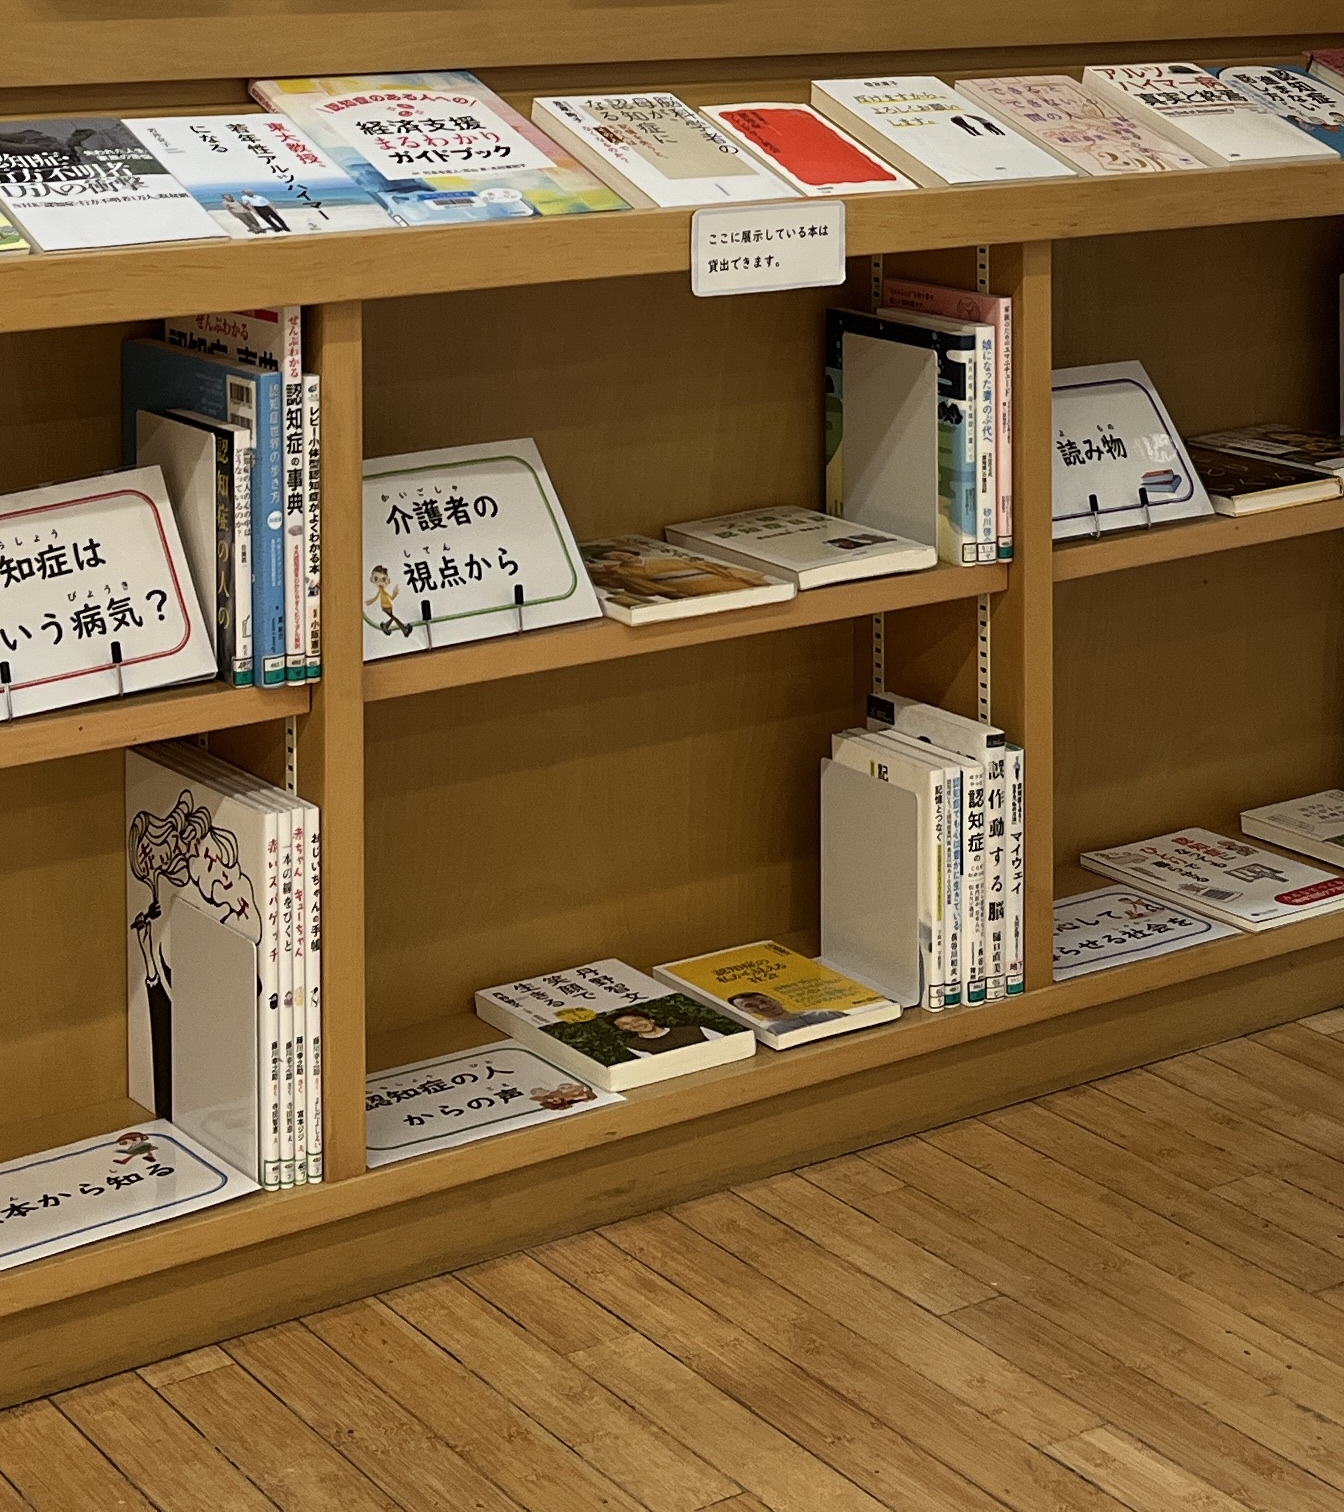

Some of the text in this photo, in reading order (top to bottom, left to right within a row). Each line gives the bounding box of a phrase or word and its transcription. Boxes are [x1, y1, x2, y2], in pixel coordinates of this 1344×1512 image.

[1092, 66, 1164, 80] アルツ
[1119, 76, 1231, 91] ハイマー病
[190, 125, 228, 153] になる
[355, 116, 487, 136] 経済支援
[374, 133, 501, 151] まるわかり
[654, 97, 739, 155] 脳科学者の
[225, 123, 329, 220] 若年性アルツハイマー
[388, 146, 512, 165] ガイドブック
[5, 178, 148, 197] 1万人の衝撃
[708, 225, 828, 246] ここに展示している本は
[708, 254, 780, 274] 貸出できます。
[286, 315, 303, 515] ぜんぶわかる 認知症の事典
[1056, 433, 1126, 467] 読み物
[216, 437, 229, 629] 認知症の人の
[386, 494, 498, 536] 介護者の
[404, 547, 519, 594] 視点から
[935, 786, 943, 842] 記憶とつなぐ
[988, 760, 1005, 922] 誤作動する脳
[1011, 833, 1022, 895] マイウェイ
[293, 828, 304, 956] 赤ちゃん キューちゃん
[311, 833, 320, 951] おじいちゃんの手帳
[576, 968, 649, 1003] 丹野智文
[404, 1088, 523, 1126] からの声
